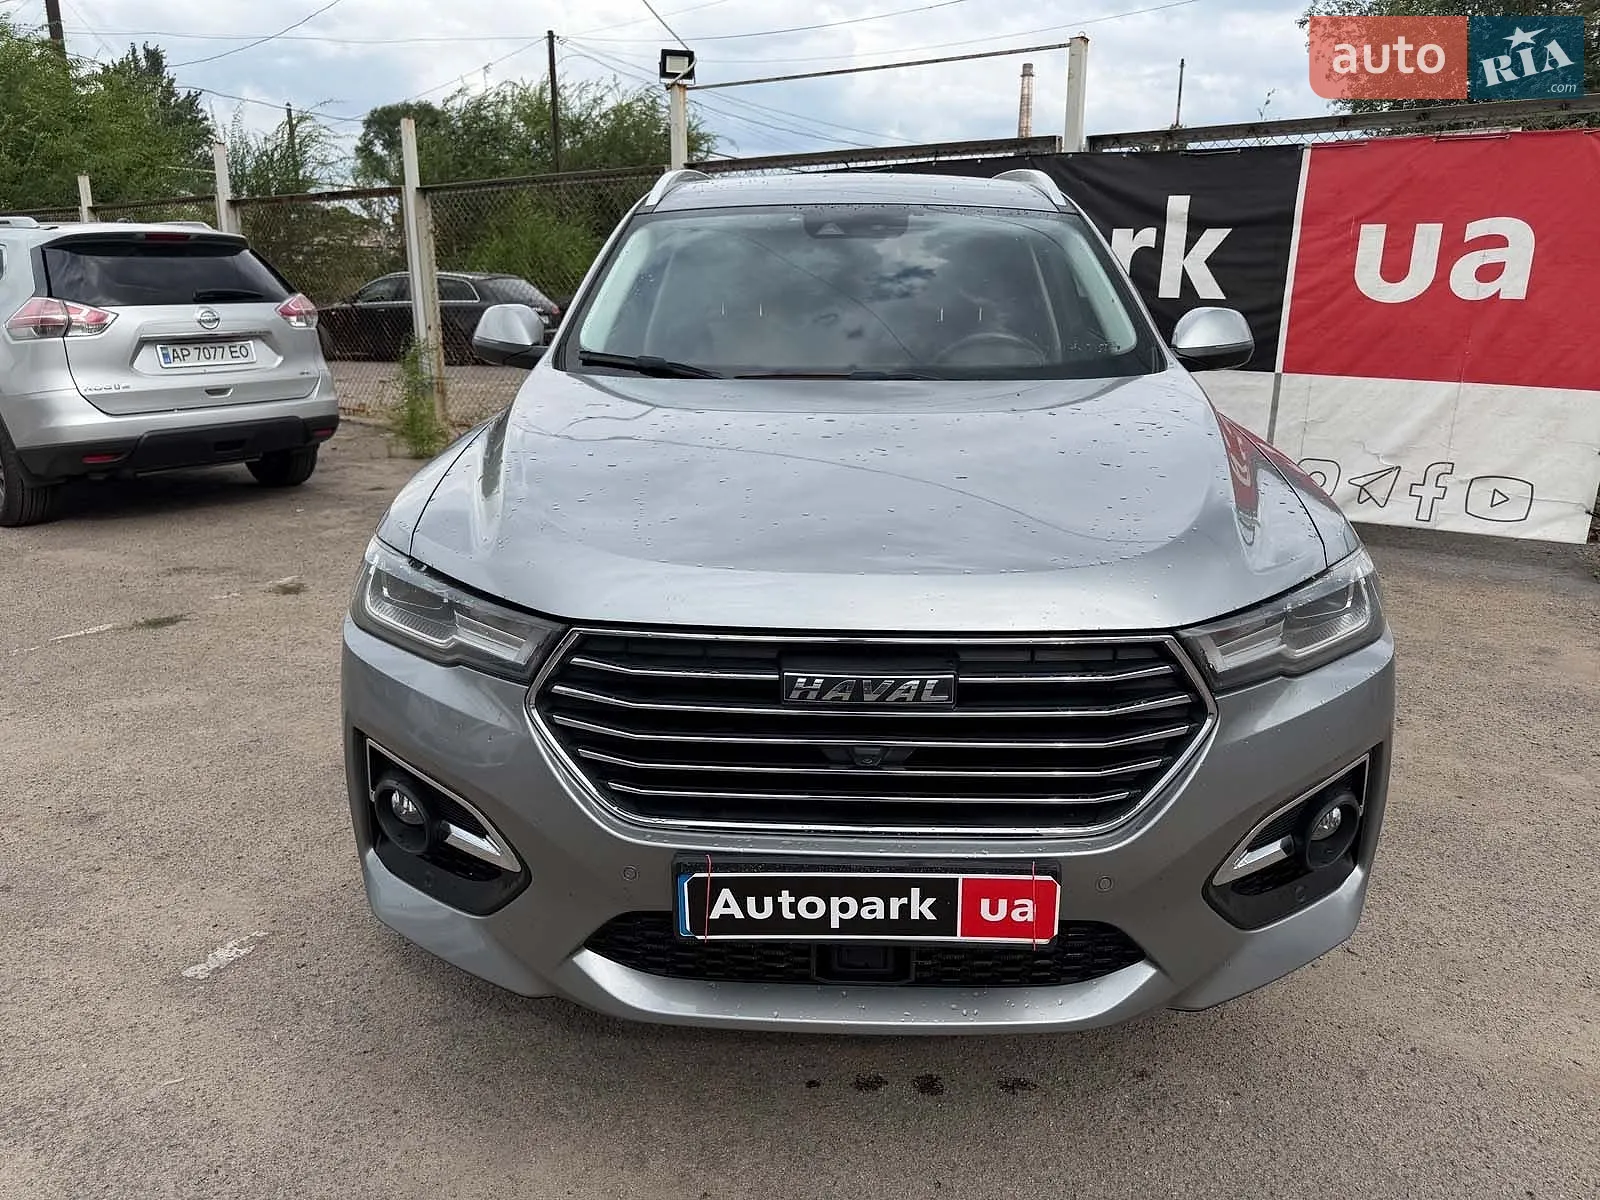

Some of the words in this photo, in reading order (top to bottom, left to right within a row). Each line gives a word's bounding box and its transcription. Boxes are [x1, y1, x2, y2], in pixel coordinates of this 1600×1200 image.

[1354, 217, 1536, 303] ua
[172, 347, 191, 362] AP
[193, 346, 225, 361] 7077
[229, 345, 249, 359] EO
[789, 678, 949, 701] HAVAL
[709, 887, 937, 929] Autopark
[979, 897, 1035, 922] ua
